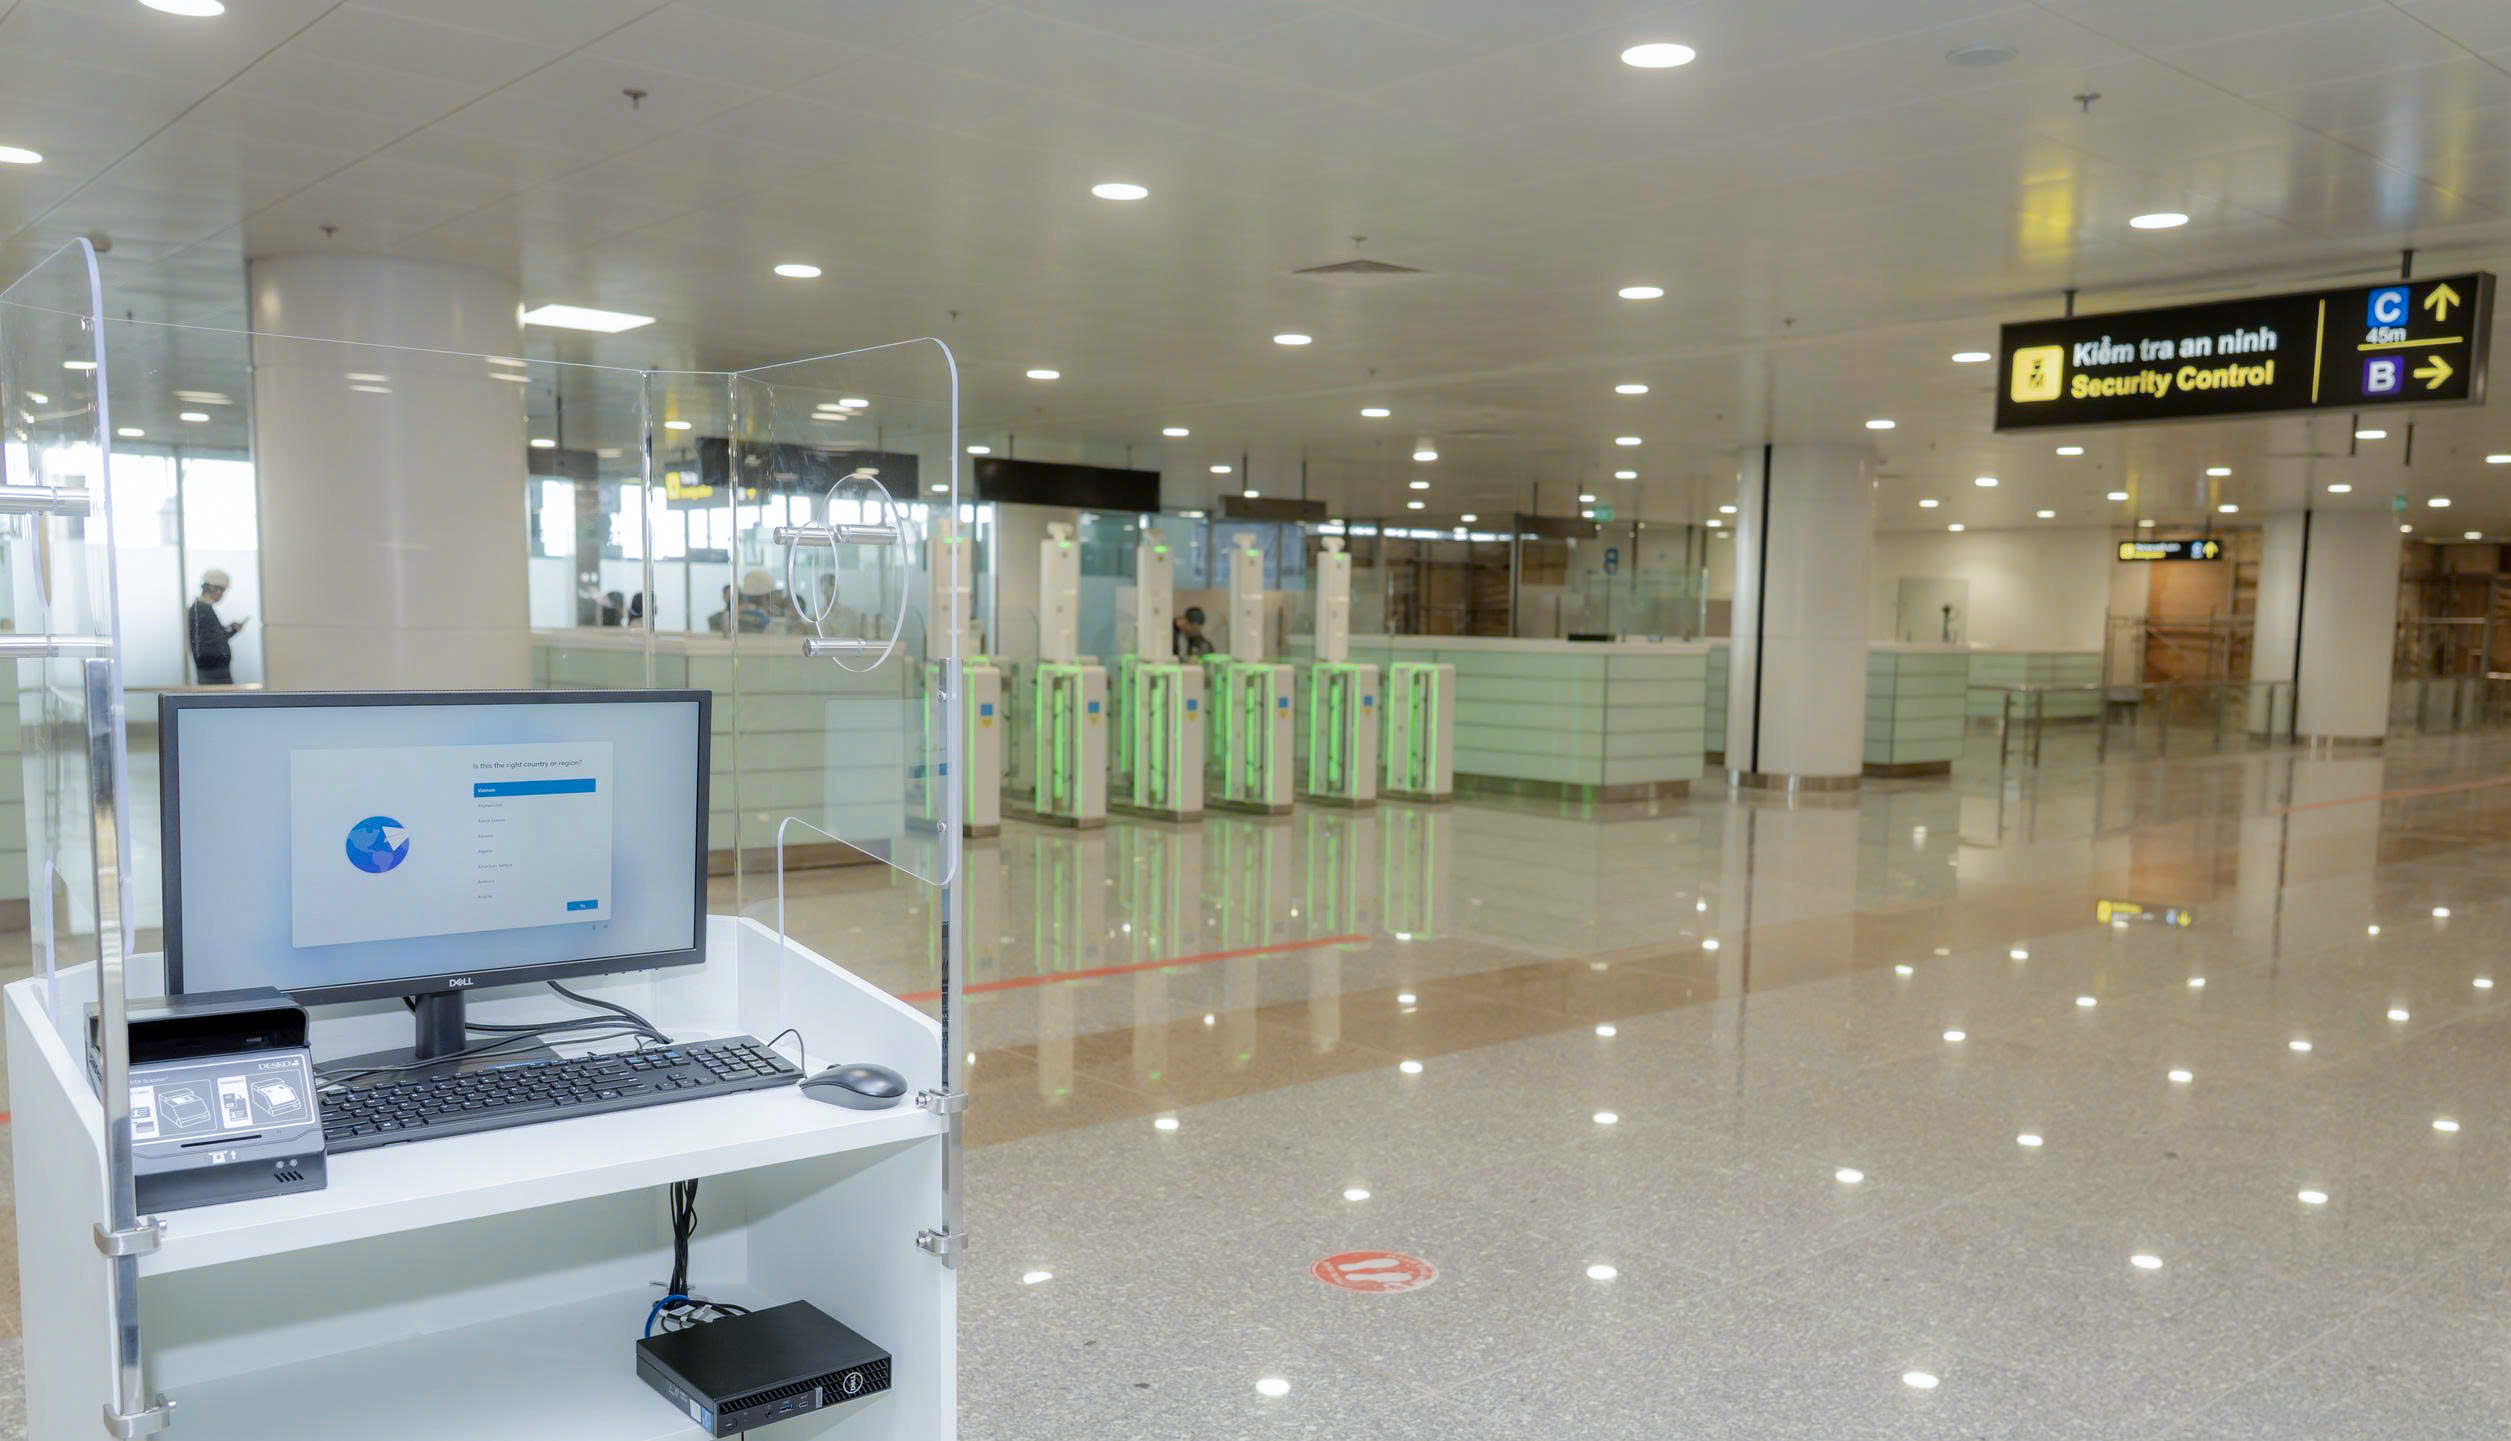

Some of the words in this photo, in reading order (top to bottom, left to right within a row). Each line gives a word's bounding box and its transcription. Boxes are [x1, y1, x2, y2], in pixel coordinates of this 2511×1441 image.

[2374, 291, 2402, 324] C
[2139, 338, 2175, 362] tra
[2178, 336, 2213, 359] an
[2217, 326, 2278, 356] ninh
[2365, 326, 2407, 344] 45m
[2070, 370, 2173, 399] Security
[2176, 359, 2275, 392] Control
[2367, 360, 2396, 393] B
[506, 761, 523, 770] right
[523, 760, 549, 769] country
[558, 759, 583, 768] region?
[449, 977, 474, 988] DELL
